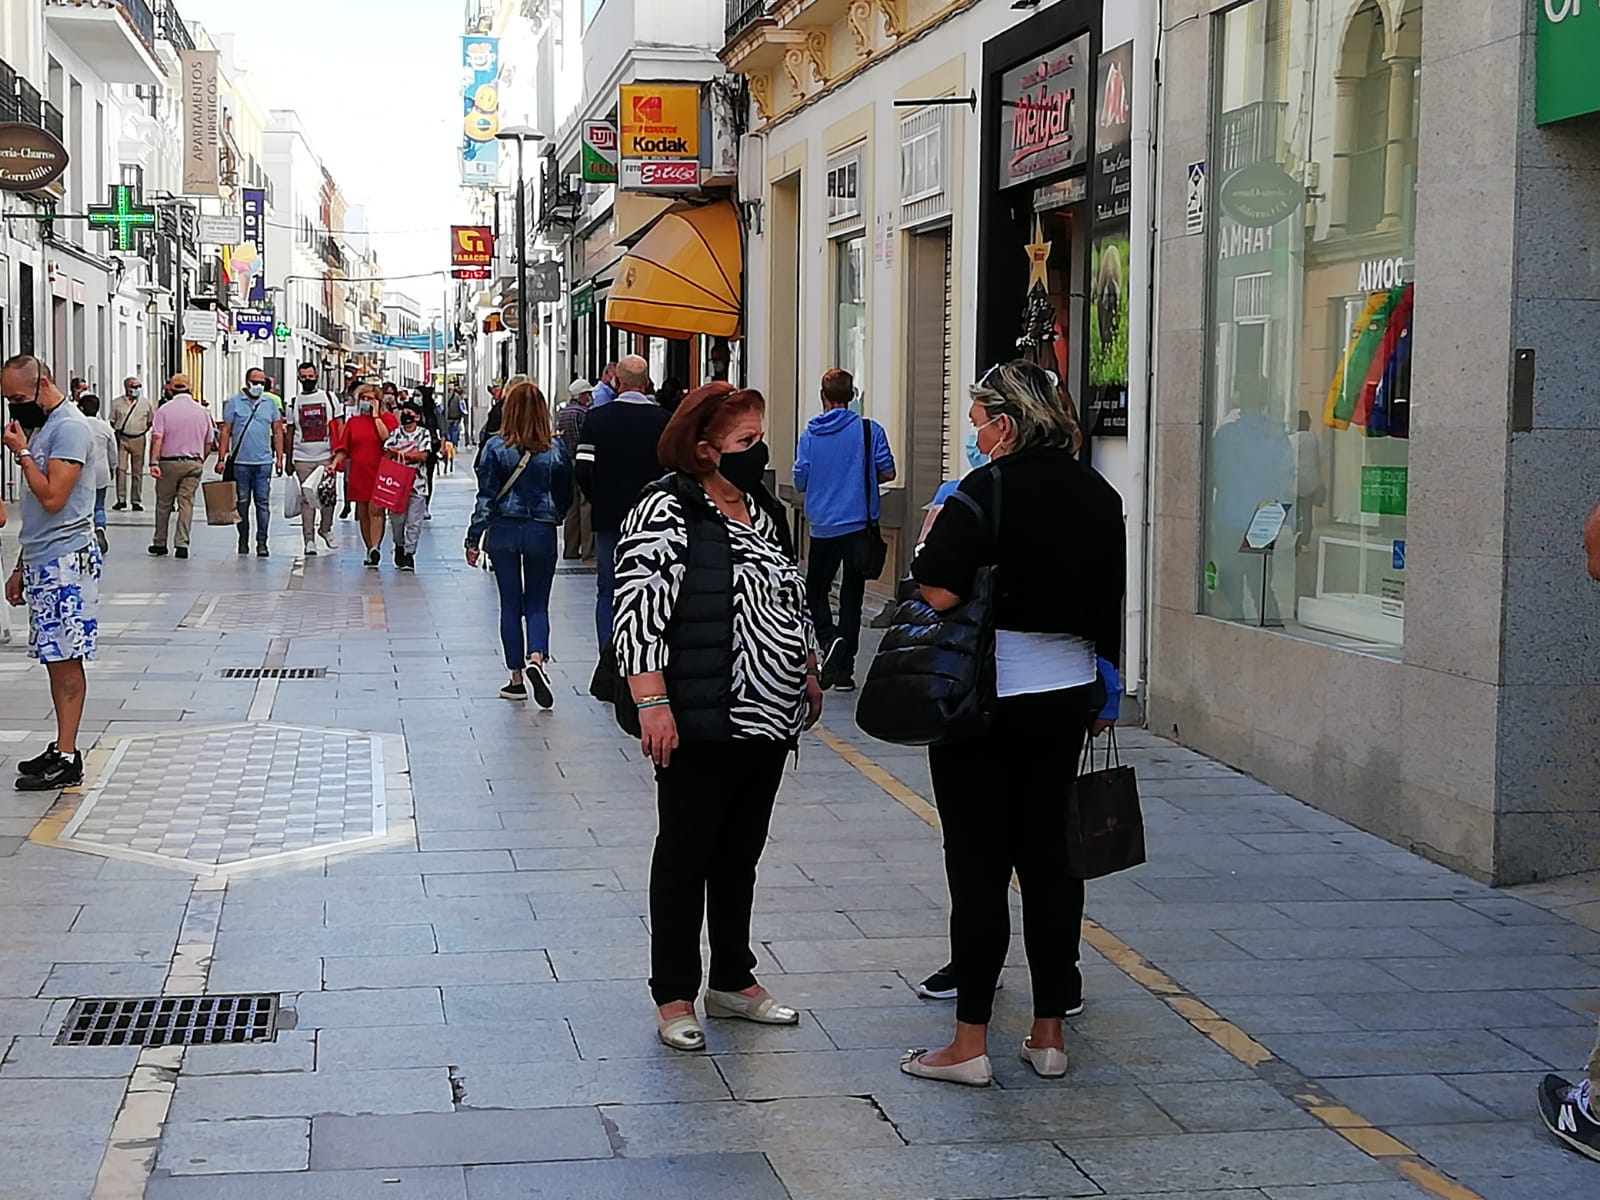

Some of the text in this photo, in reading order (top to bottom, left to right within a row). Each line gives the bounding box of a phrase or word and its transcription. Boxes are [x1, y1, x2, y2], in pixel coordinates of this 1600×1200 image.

[192, 61, 203, 161] APARTAMENTOS
[207, 76, 218, 146] TURISTICOS
[1012, 85, 1074, 150] Melgar
[589, 128, 614, 147] FUJI
[633, 136, 689, 153] Kodak
[0, 165, 53, 182] Corralillo
[453, 254, 490, 262] TABACOS
